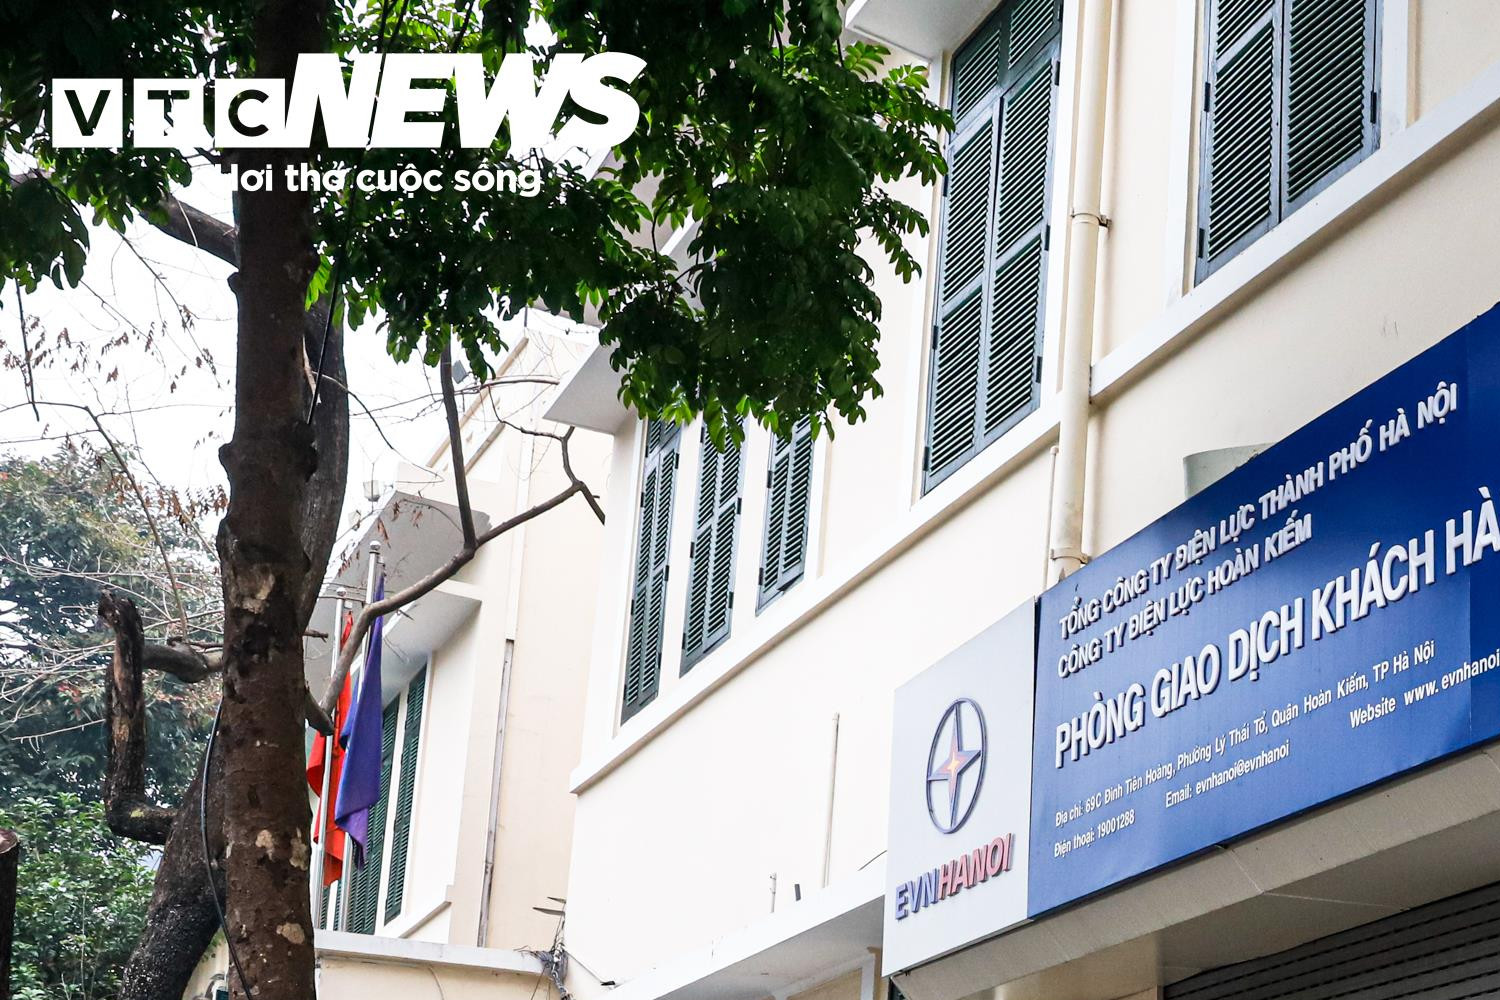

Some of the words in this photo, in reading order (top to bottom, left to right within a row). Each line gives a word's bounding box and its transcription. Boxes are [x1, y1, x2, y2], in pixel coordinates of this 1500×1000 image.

[1058, 638, 1103, 679] CÔNG
[1104, 622, 1127, 653] TY
[1129, 598, 1168, 641] ĐIỆN
[1169, 576, 1205, 616] LỰC
[1208, 543, 1260, 596] HOÀN
[1264, 509, 1312, 563] KIẾM
[1059, 595, 1101, 640] TỔNG
[1103, 569, 1150, 614] CÔNG
[1150, 552, 1174, 585] TY
[1175, 529, 1216, 571] ĐIỆN
[1219, 504, 1255, 545] LỰC
[1258, 461, 1324, 520] THÀNH
[1328, 418, 1373, 481] PHỐ
[1379, 407, 1411, 451] HÀ
[1417, 381, 1457, 430] NỘI
[1055, 682, 1146, 769] PHÒNG
[1150, 642, 1222, 719] GIAO
[1228, 597, 1304, 682] DỊCH
[1311, 528, 1436, 642] KHÁCH
[1085, 791, 1102, 814] 69C
[1125, 775, 1143, 795] Tiên
[1215, 735, 1226, 756] Lý
[1229, 722, 1250, 746] Thái
[1271, 703, 1299, 728] Quận
[1303, 689, 1332, 715] Hoàn
[1337, 671, 1369, 699] Kiếm,
[1372, 660, 1390, 683] TP
[1393, 650, 1410, 675] Hà
[1414, 639, 1435, 666] Nội
[1054, 840, 1072, 858] Điện
[1097, 809, 1136, 838] 19001288
[1165, 783, 1192, 808] Email:
[1196, 739, 1290, 795] evnhanoi@evnhanoi
[1350, 696, 1397, 728] Website
[895, 832, 1014, 921] EVNHANOI
